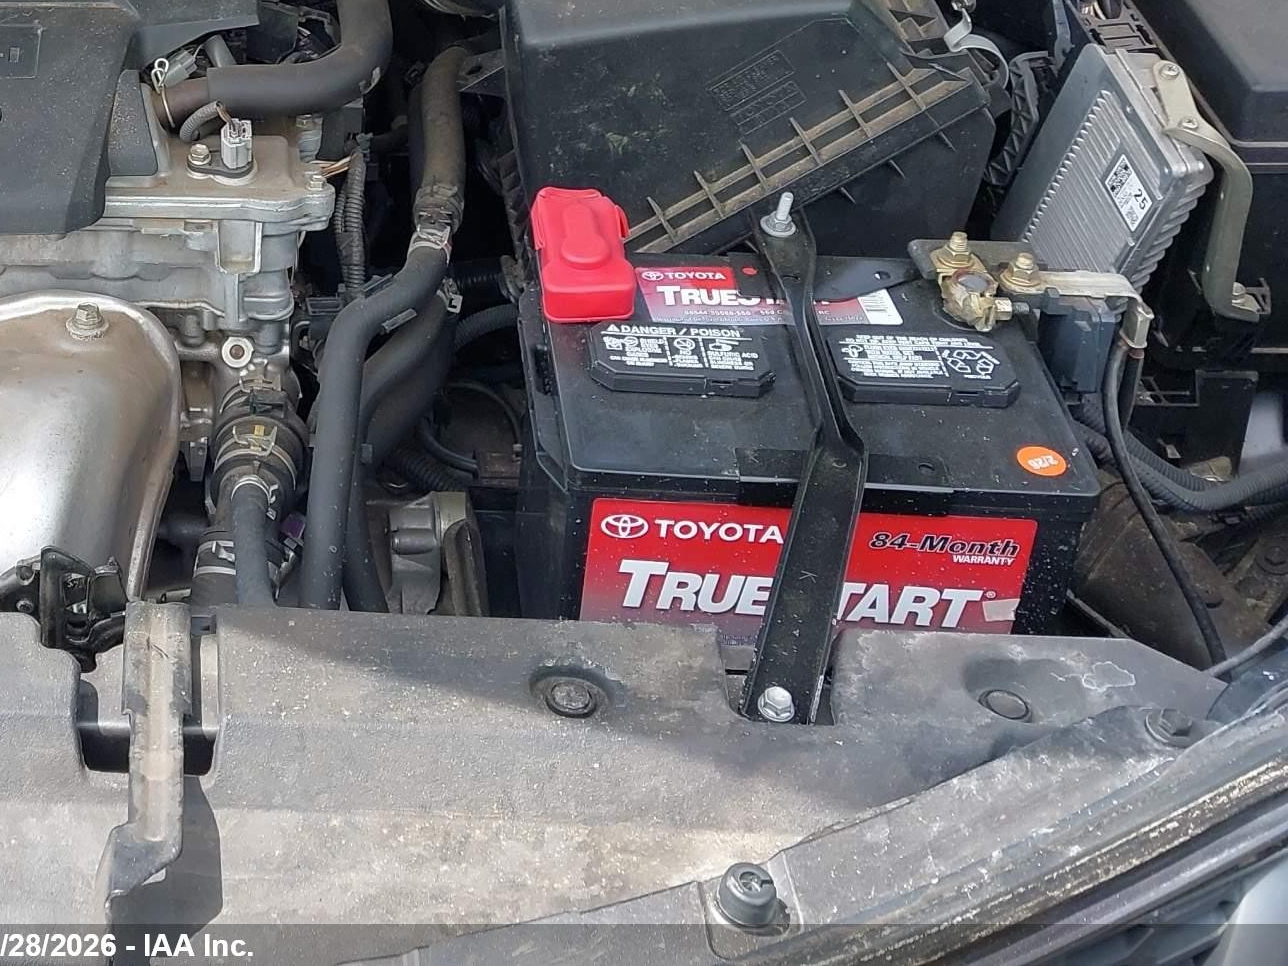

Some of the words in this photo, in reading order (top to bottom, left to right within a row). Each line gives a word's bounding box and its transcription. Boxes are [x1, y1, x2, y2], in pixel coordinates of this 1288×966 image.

[1133, 187, 1148, 210] 25
[665, 271, 726, 281] TOYOTA
[621, 324, 677, 335] DANGER
[689, 328, 741, 338] POISON
[654, 519, 784, 544] TOYOTA
[869, 530, 1020, 557] 84-Month
[952, 554, 1015, 566] WARRANTY
